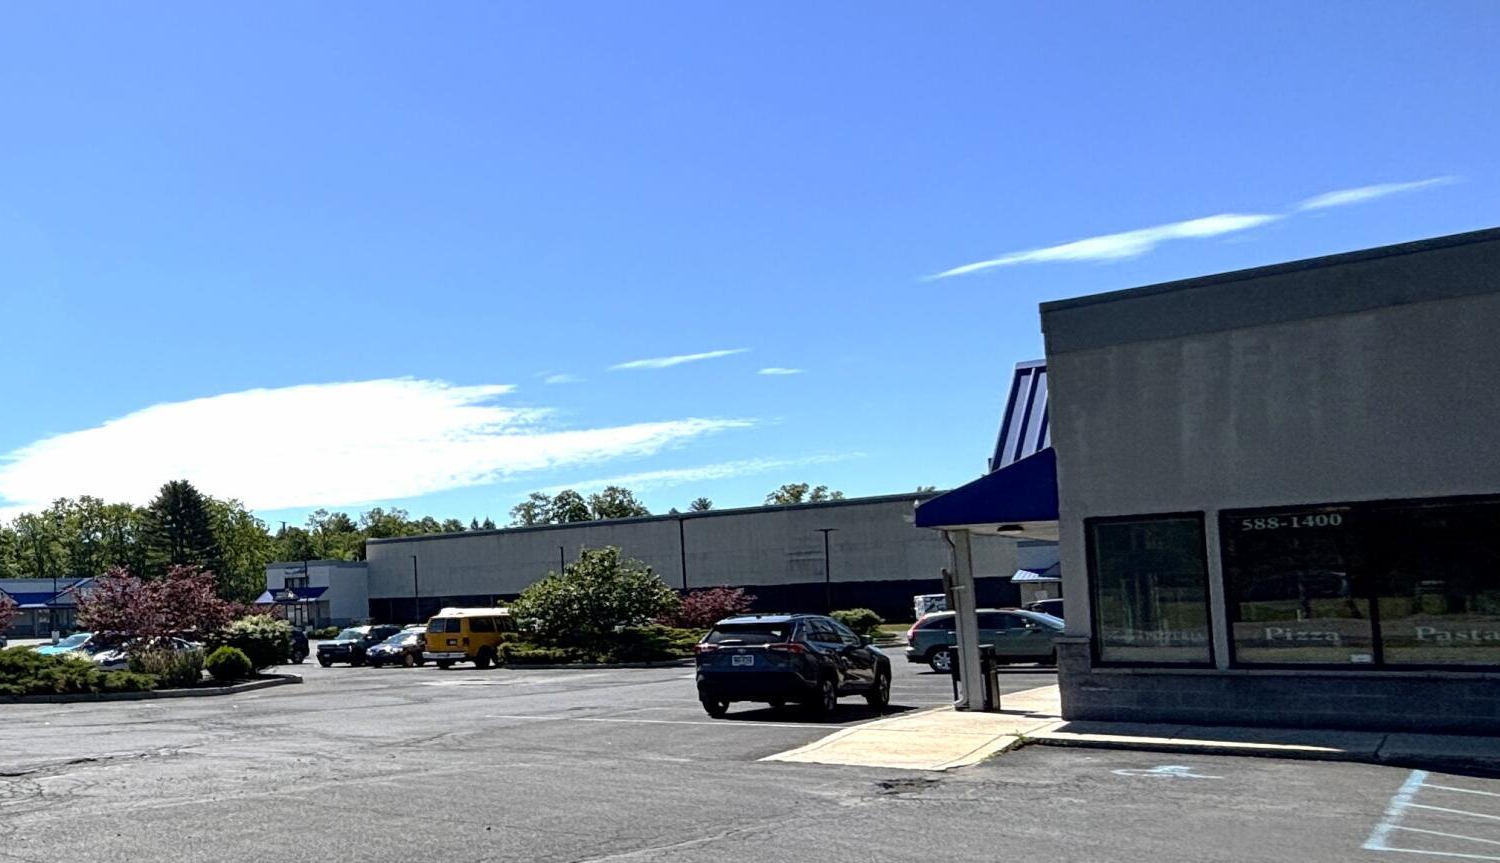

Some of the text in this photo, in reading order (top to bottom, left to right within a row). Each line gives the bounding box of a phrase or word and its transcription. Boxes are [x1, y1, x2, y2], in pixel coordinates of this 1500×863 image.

[1241, 512, 1343, 532] 588-1400
[1265, 626, 1340, 642] Pizza
[1415, 625, 1500, 642] Pasta
